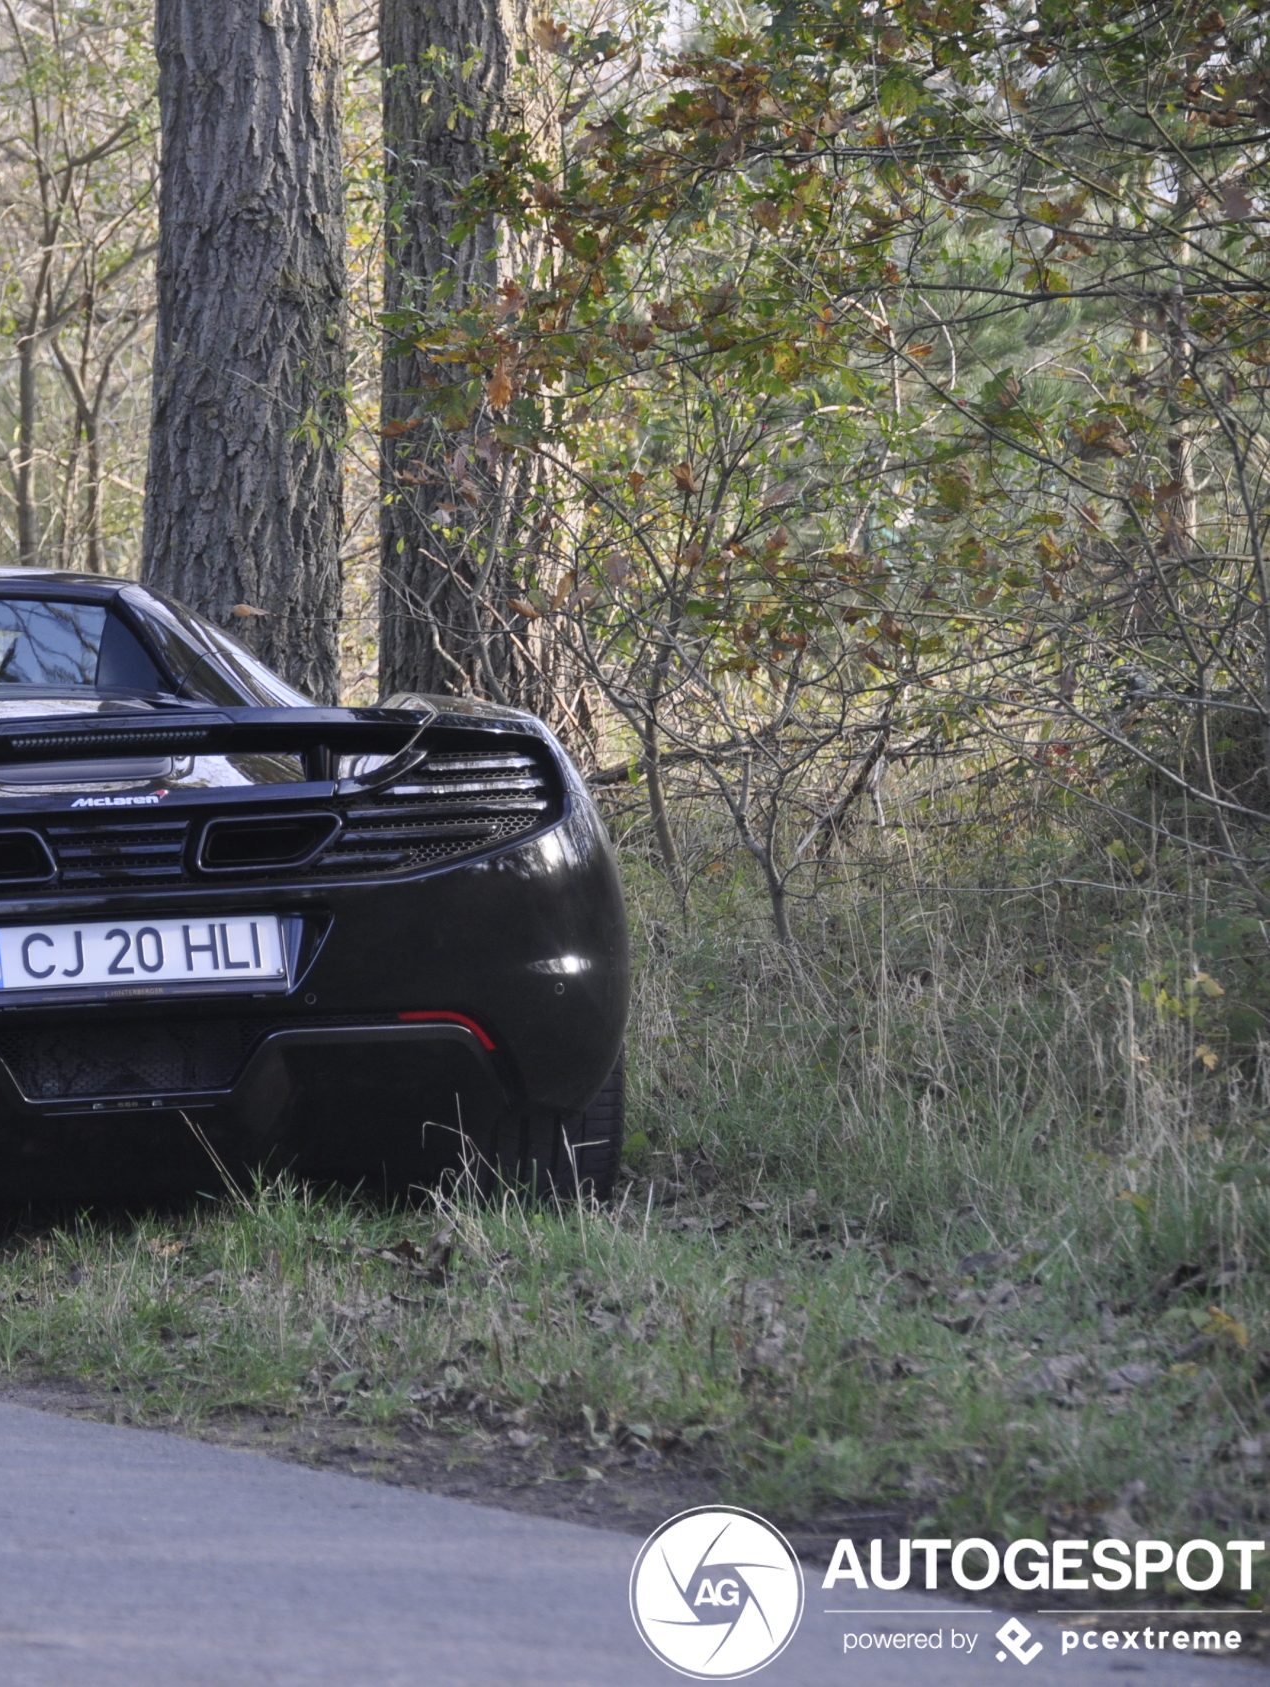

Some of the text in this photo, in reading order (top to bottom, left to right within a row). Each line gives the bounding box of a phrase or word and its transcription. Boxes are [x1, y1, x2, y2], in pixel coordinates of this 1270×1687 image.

[71, 795, 159, 808] McLaren
[21, 922, 262, 979] CJ 20 HLI
[111, 987, 164, 997] HINTERBERGER
